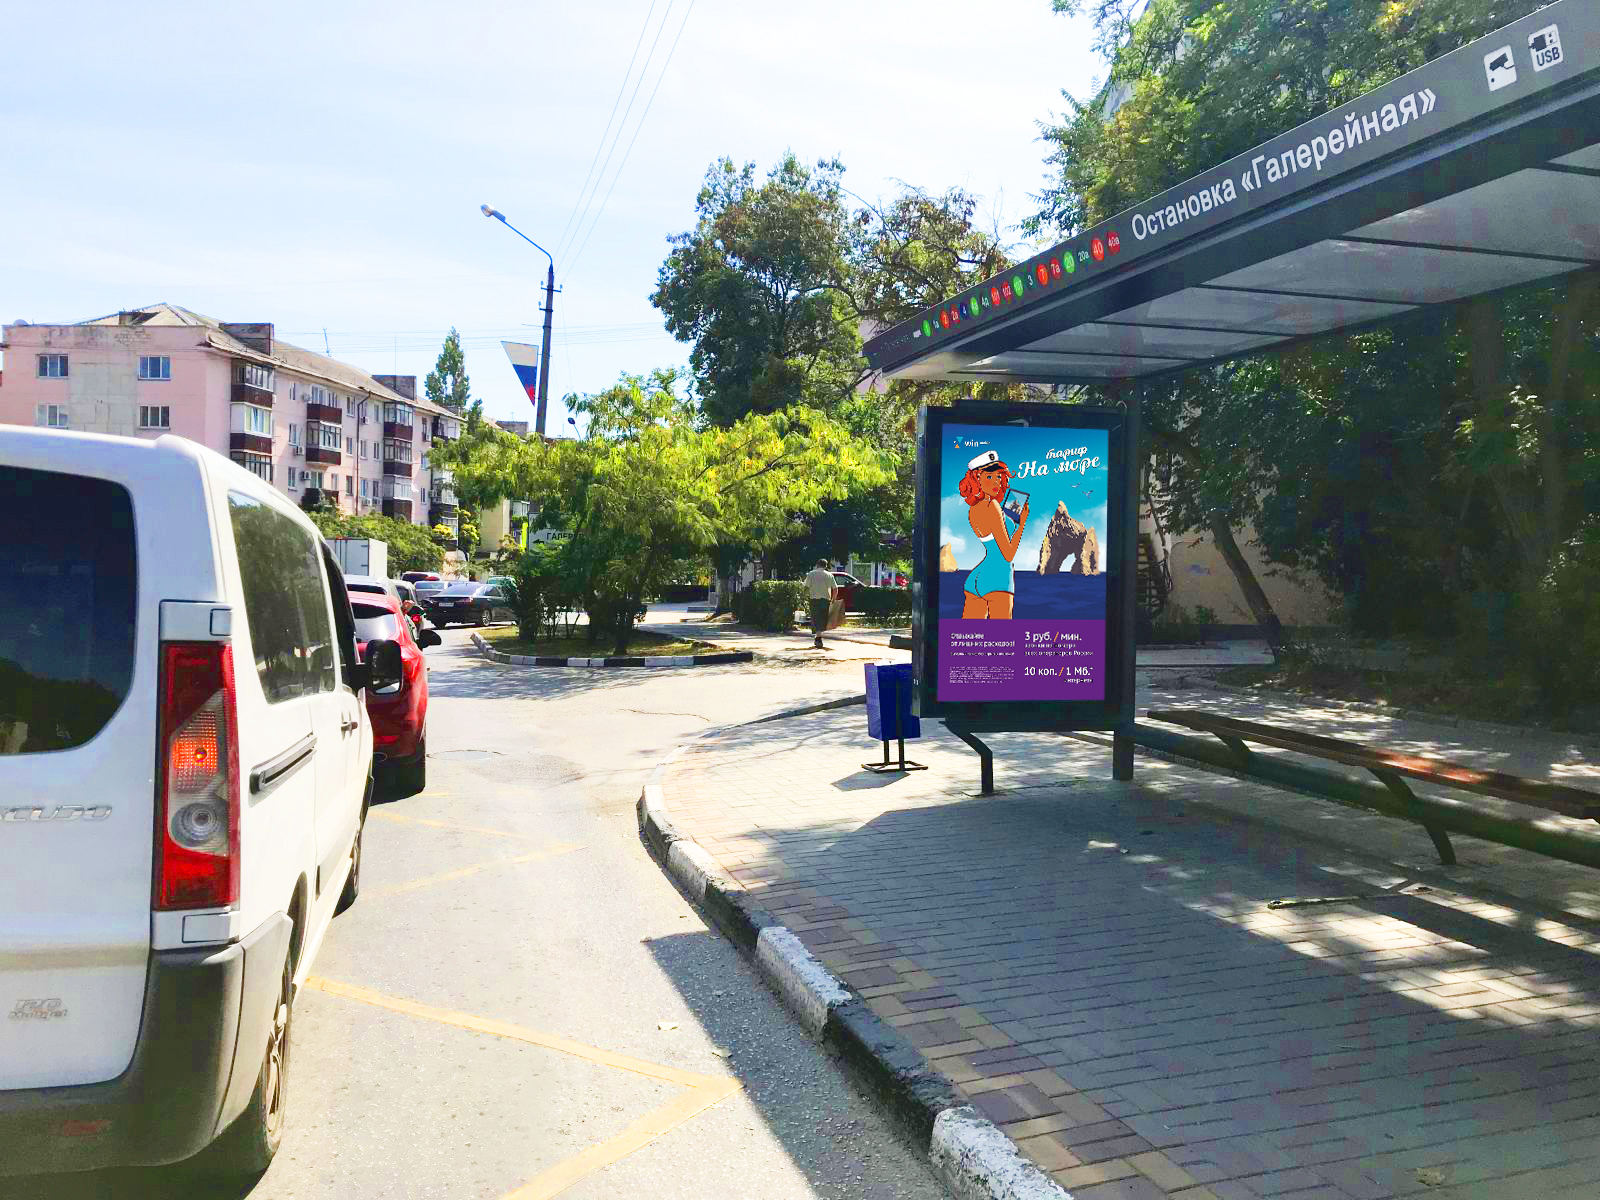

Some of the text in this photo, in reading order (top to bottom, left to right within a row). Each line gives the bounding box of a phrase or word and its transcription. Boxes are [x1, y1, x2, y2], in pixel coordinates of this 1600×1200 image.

[1536, 46, 1560, 67] USB
[1131, 88, 1437, 241] Остановка «Галерейная»
[1027, 274, 1033, 286] 3
[1093, 243, 1103, 256] 40
[1046, 446, 1088, 461] тариф
[1017, 456, 1101, 479] На море
[1024, 631, 1031, 641] 3
[1032, 631, 1052, 643] руб.
[1060, 633, 1082, 641] мин.
[1024, 666, 1036, 676] 10
[1038, 668, 1058, 676] коп.
[1066, 666, 1072, 676] 1
[0, 805, 113, 823] CUDO
